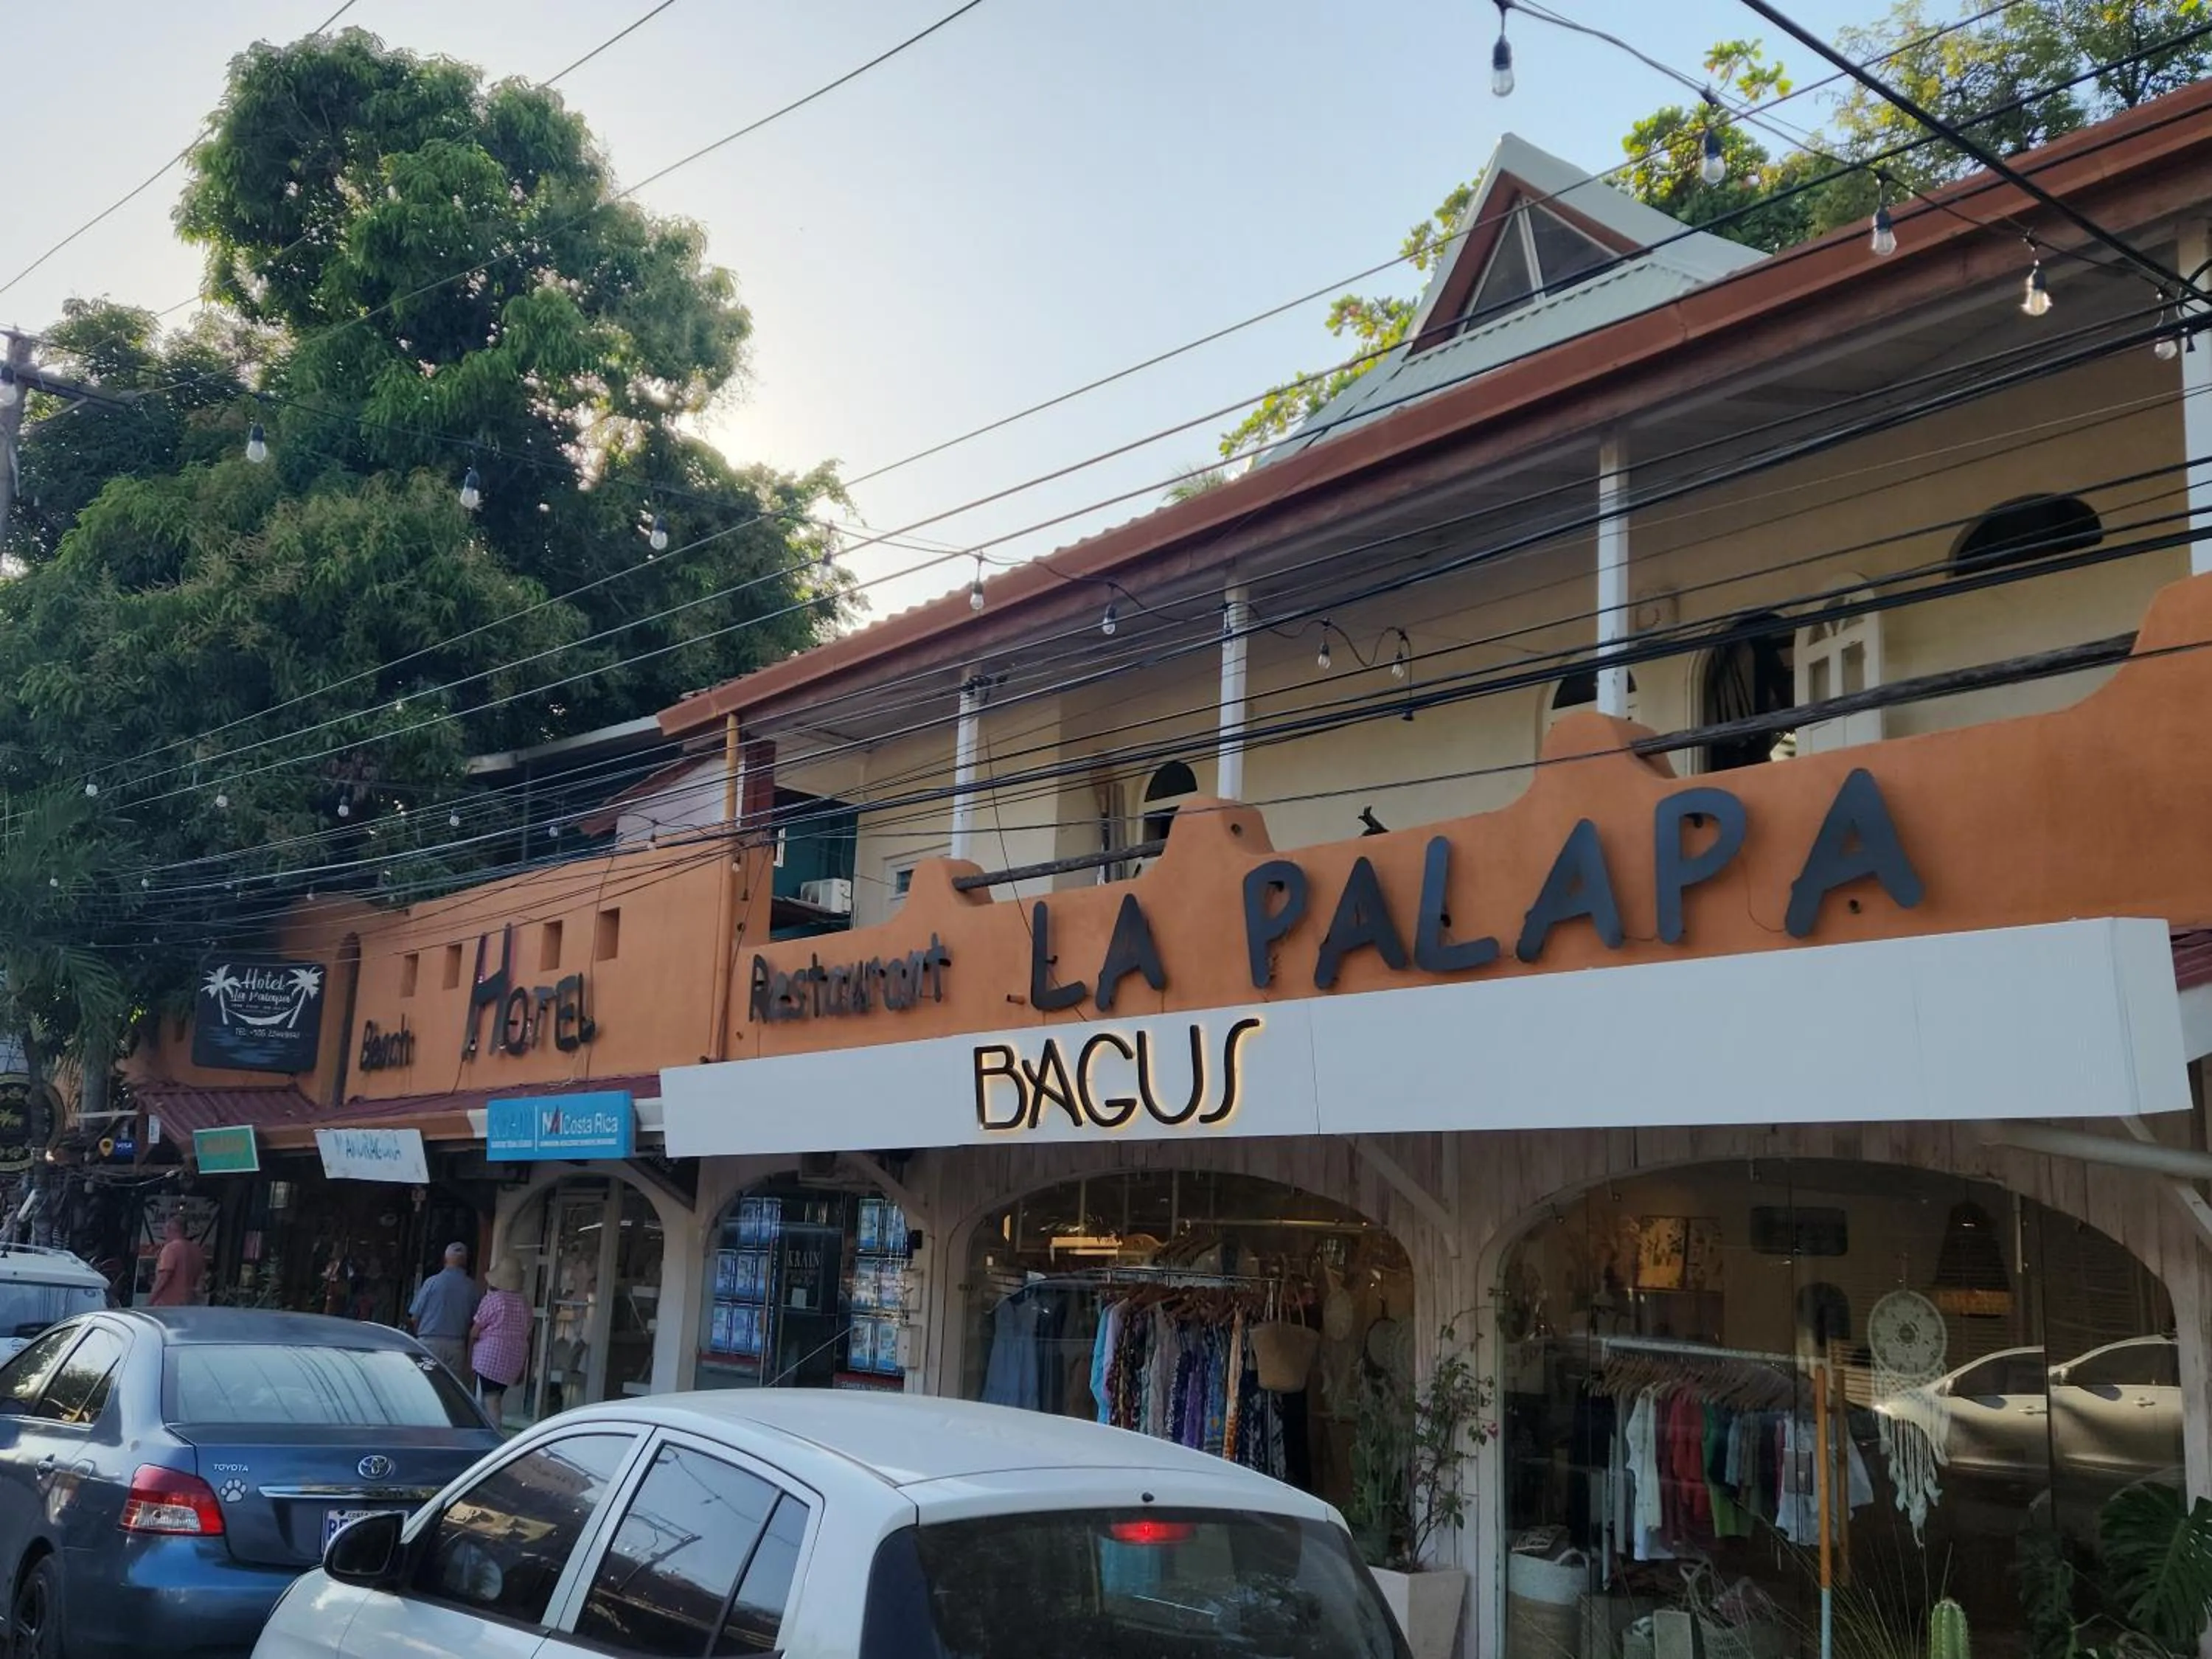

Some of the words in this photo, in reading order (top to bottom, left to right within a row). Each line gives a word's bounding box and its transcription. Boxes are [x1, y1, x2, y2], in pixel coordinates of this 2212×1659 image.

[749, 932, 947, 1023] Restaurant
[1033, 893, 1166, 1012] LA
[1242, 768, 1925, 990] PALAPA
[241, 968, 285, 990] Hotel
[974, 1018, 1260, 1130] BAGUS
[563, 1114, 591, 1135] Costa
[594, 1112, 619, 1134] Rica
[213, 1464, 248, 1472] TOYOTA
